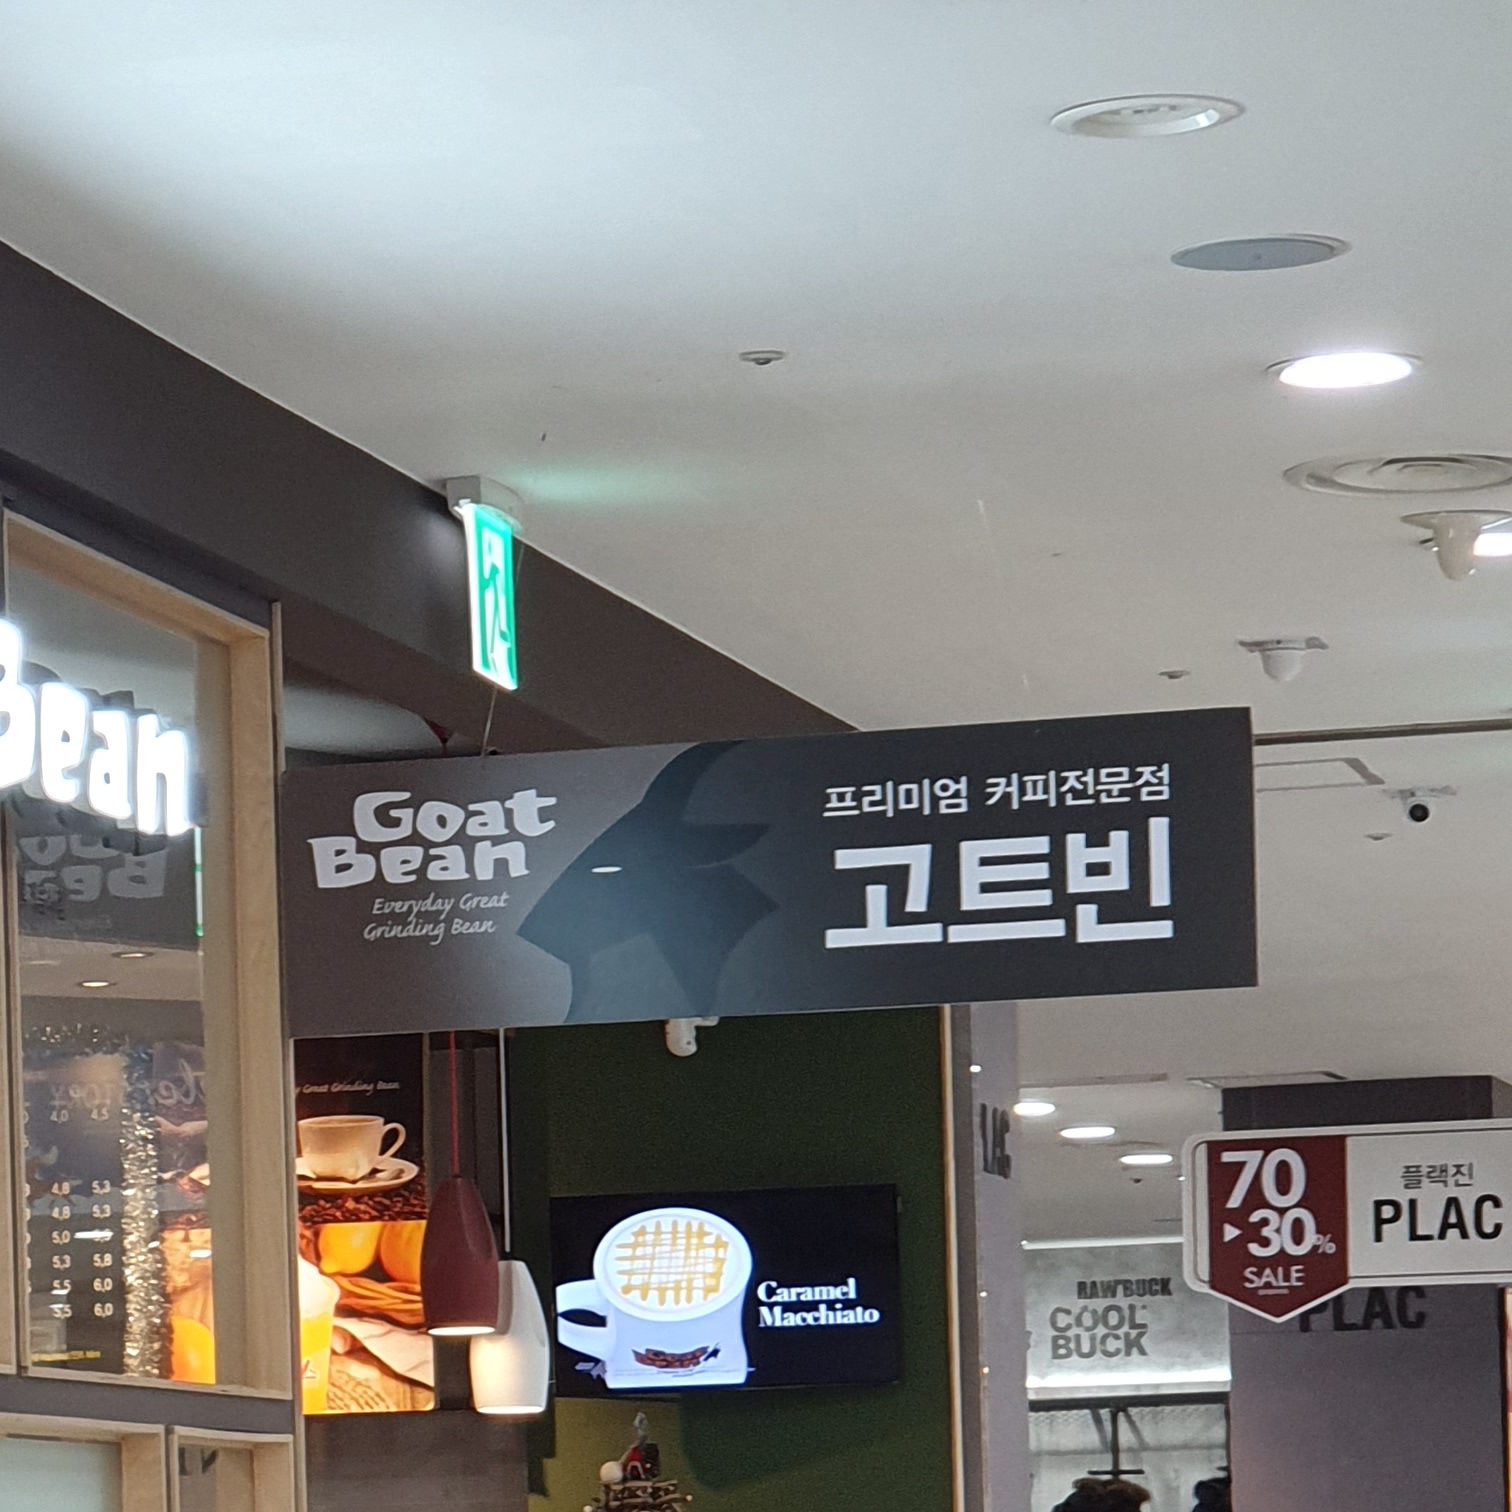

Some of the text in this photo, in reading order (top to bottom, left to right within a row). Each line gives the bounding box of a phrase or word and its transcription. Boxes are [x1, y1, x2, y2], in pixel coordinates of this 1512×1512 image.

[823, 763, 1171, 818] 프리미엄 커피전문점
[353, 788, 558, 842] Goat
[307, 836, 531, 889] Bean
[825, 816, 1175, 949] 고트빈
[372, 891, 510, 922] Everyday Great
[364, 917, 496, 945] Grinding Bean
[1220, 1147, 1306, 1209] 70
[1400, 1162, 1474, 1190] 플랙진
[1246, 1207, 1337, 1257] 30%
[1373, 1193, 1504, 1244] PLAC
[757, 1277, 857, 1302] Caramel
[1243, 1265, 1306, 1289] SALE
[758, 1303, 881, 1328] Macchiato
[1050, 1330, 1149, 1360] BUCK
